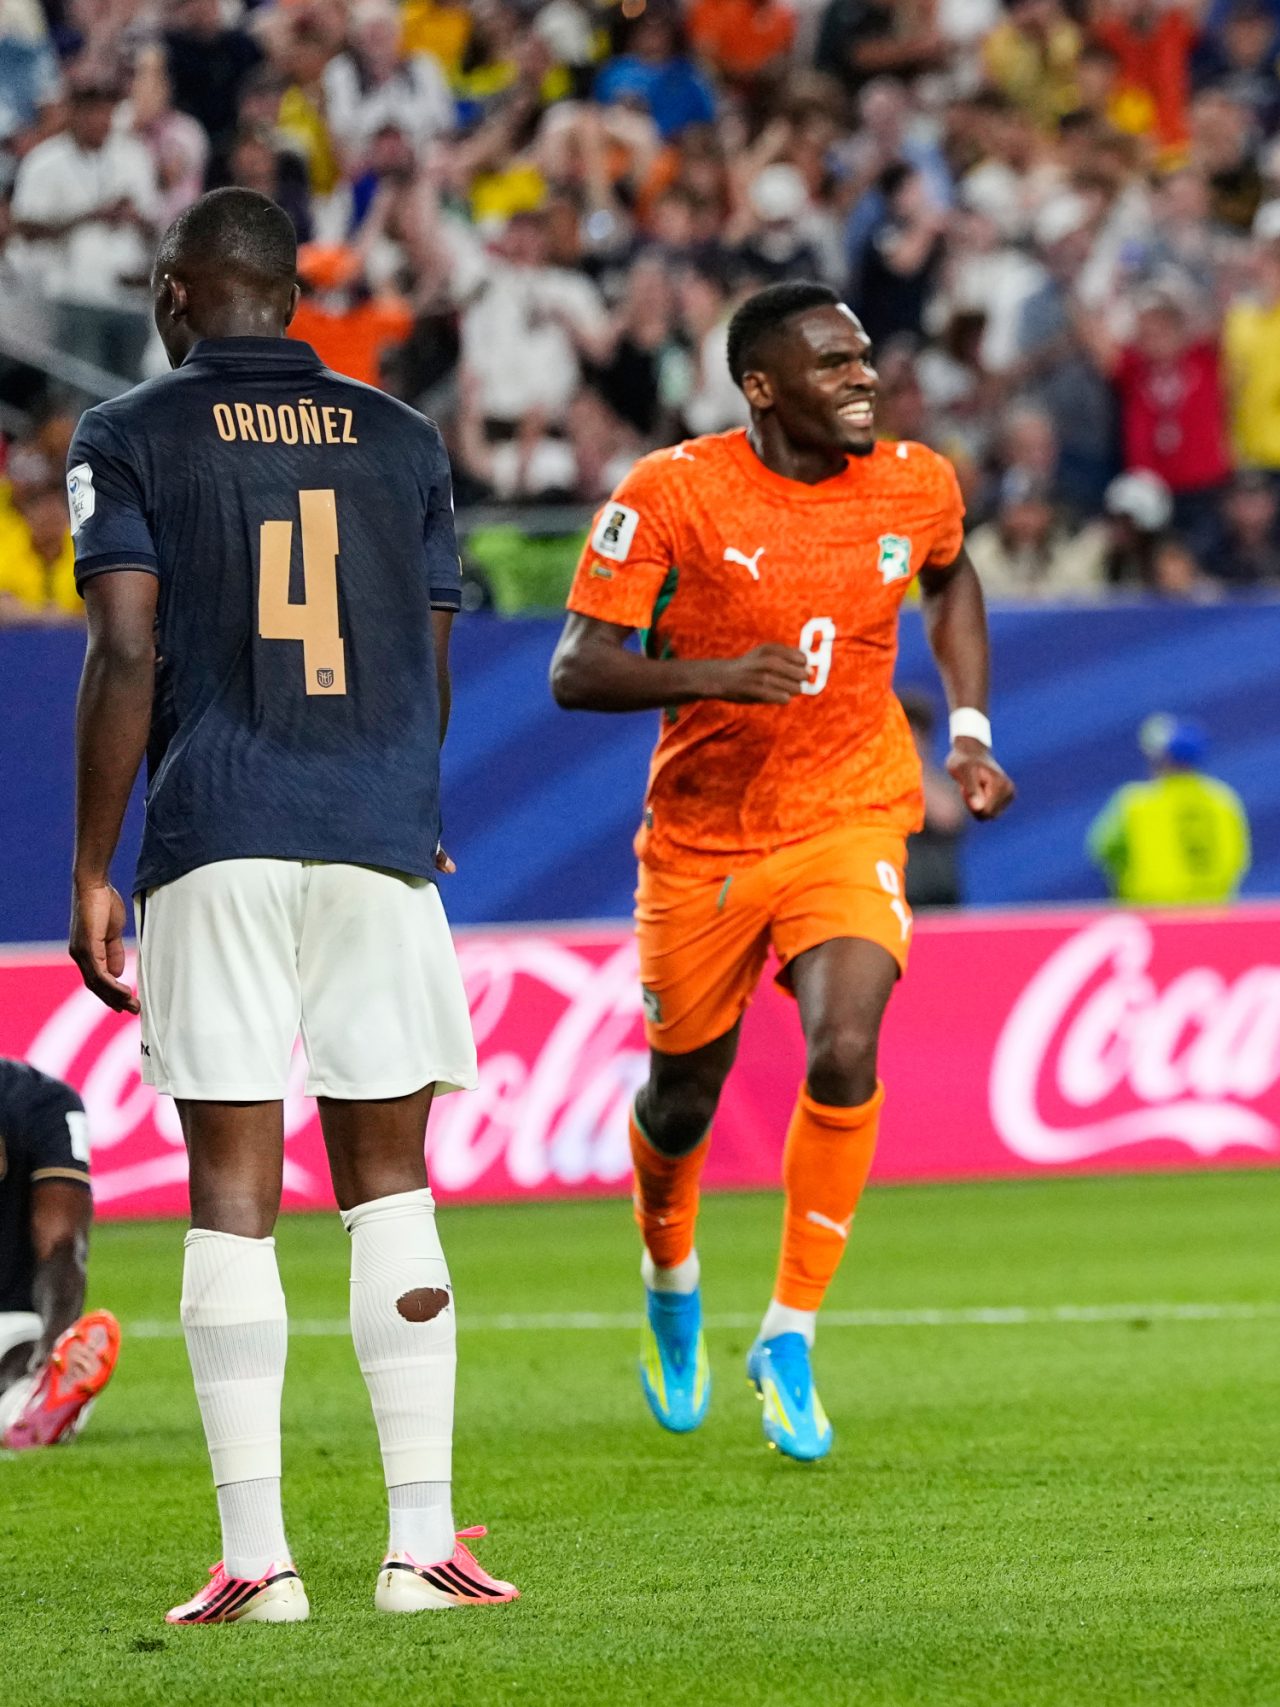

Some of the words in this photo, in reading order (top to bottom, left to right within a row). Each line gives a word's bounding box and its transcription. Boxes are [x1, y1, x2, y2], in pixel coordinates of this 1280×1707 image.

[212, 398, 359, 446] ORDOÑEZ
[258, 489, 348, 696] 4
[799, 616, 836, 696] 9
